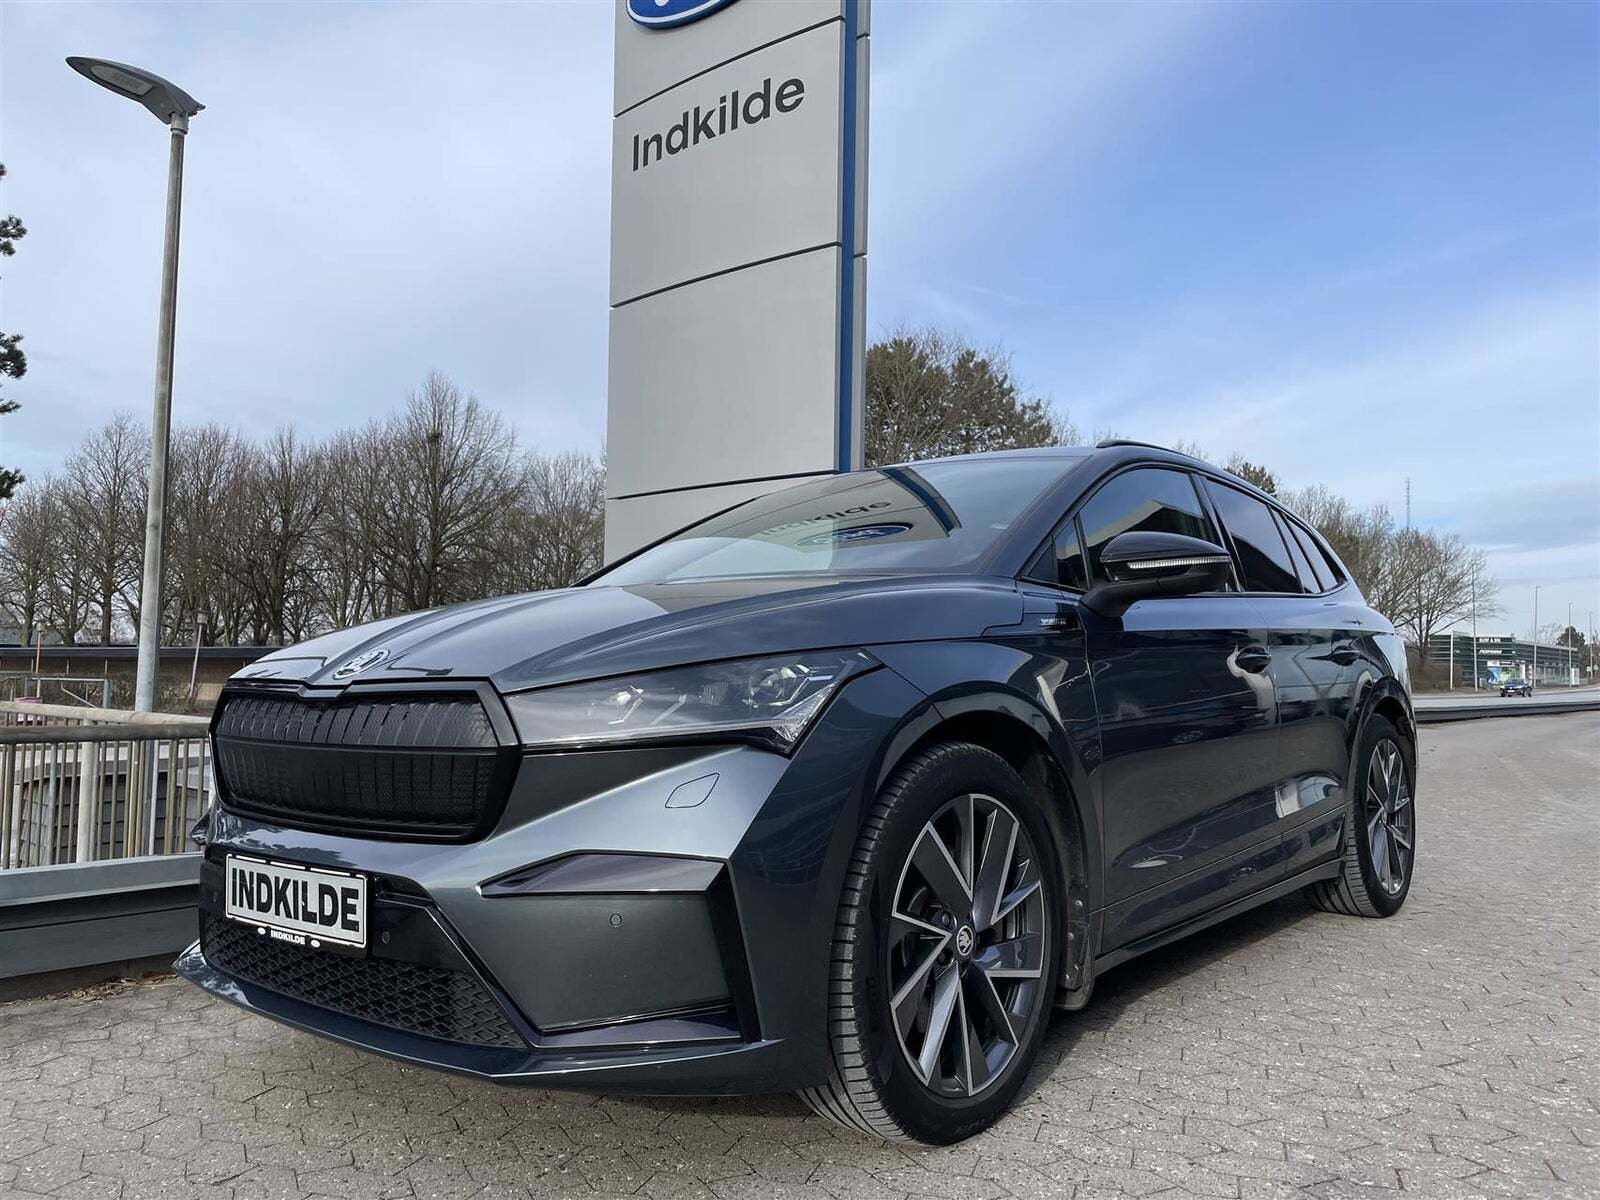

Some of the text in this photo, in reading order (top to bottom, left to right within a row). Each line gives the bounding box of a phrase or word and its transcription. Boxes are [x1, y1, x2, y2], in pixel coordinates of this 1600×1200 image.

[633, 78, 805, 172] Indkilde
[232, 868, 359, 932] INDKILDE
[270, 930, 306, 945] INDKILDE
